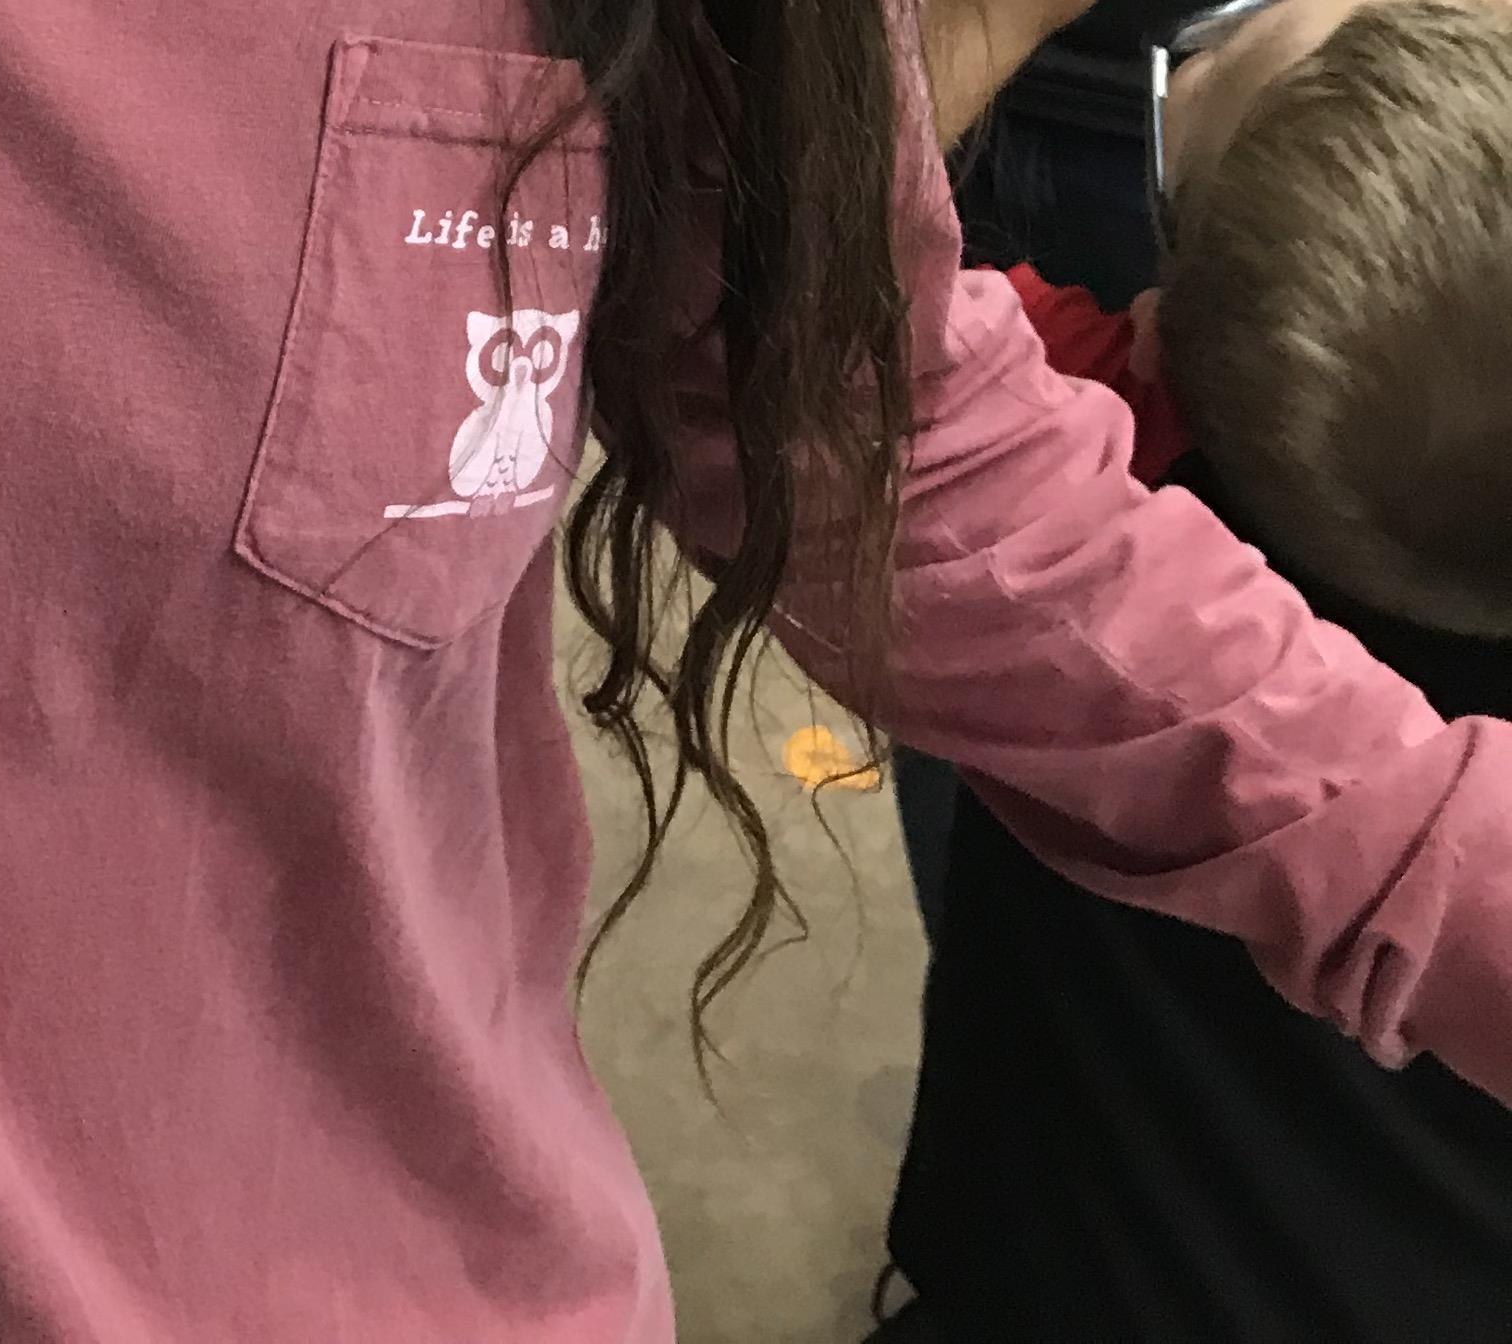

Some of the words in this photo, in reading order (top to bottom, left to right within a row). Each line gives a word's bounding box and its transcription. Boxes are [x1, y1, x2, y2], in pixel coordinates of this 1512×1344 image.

[404, 208, 495, 249] Life
[506, 210, 534, 248] is
[548, 223, 570, 250] a
